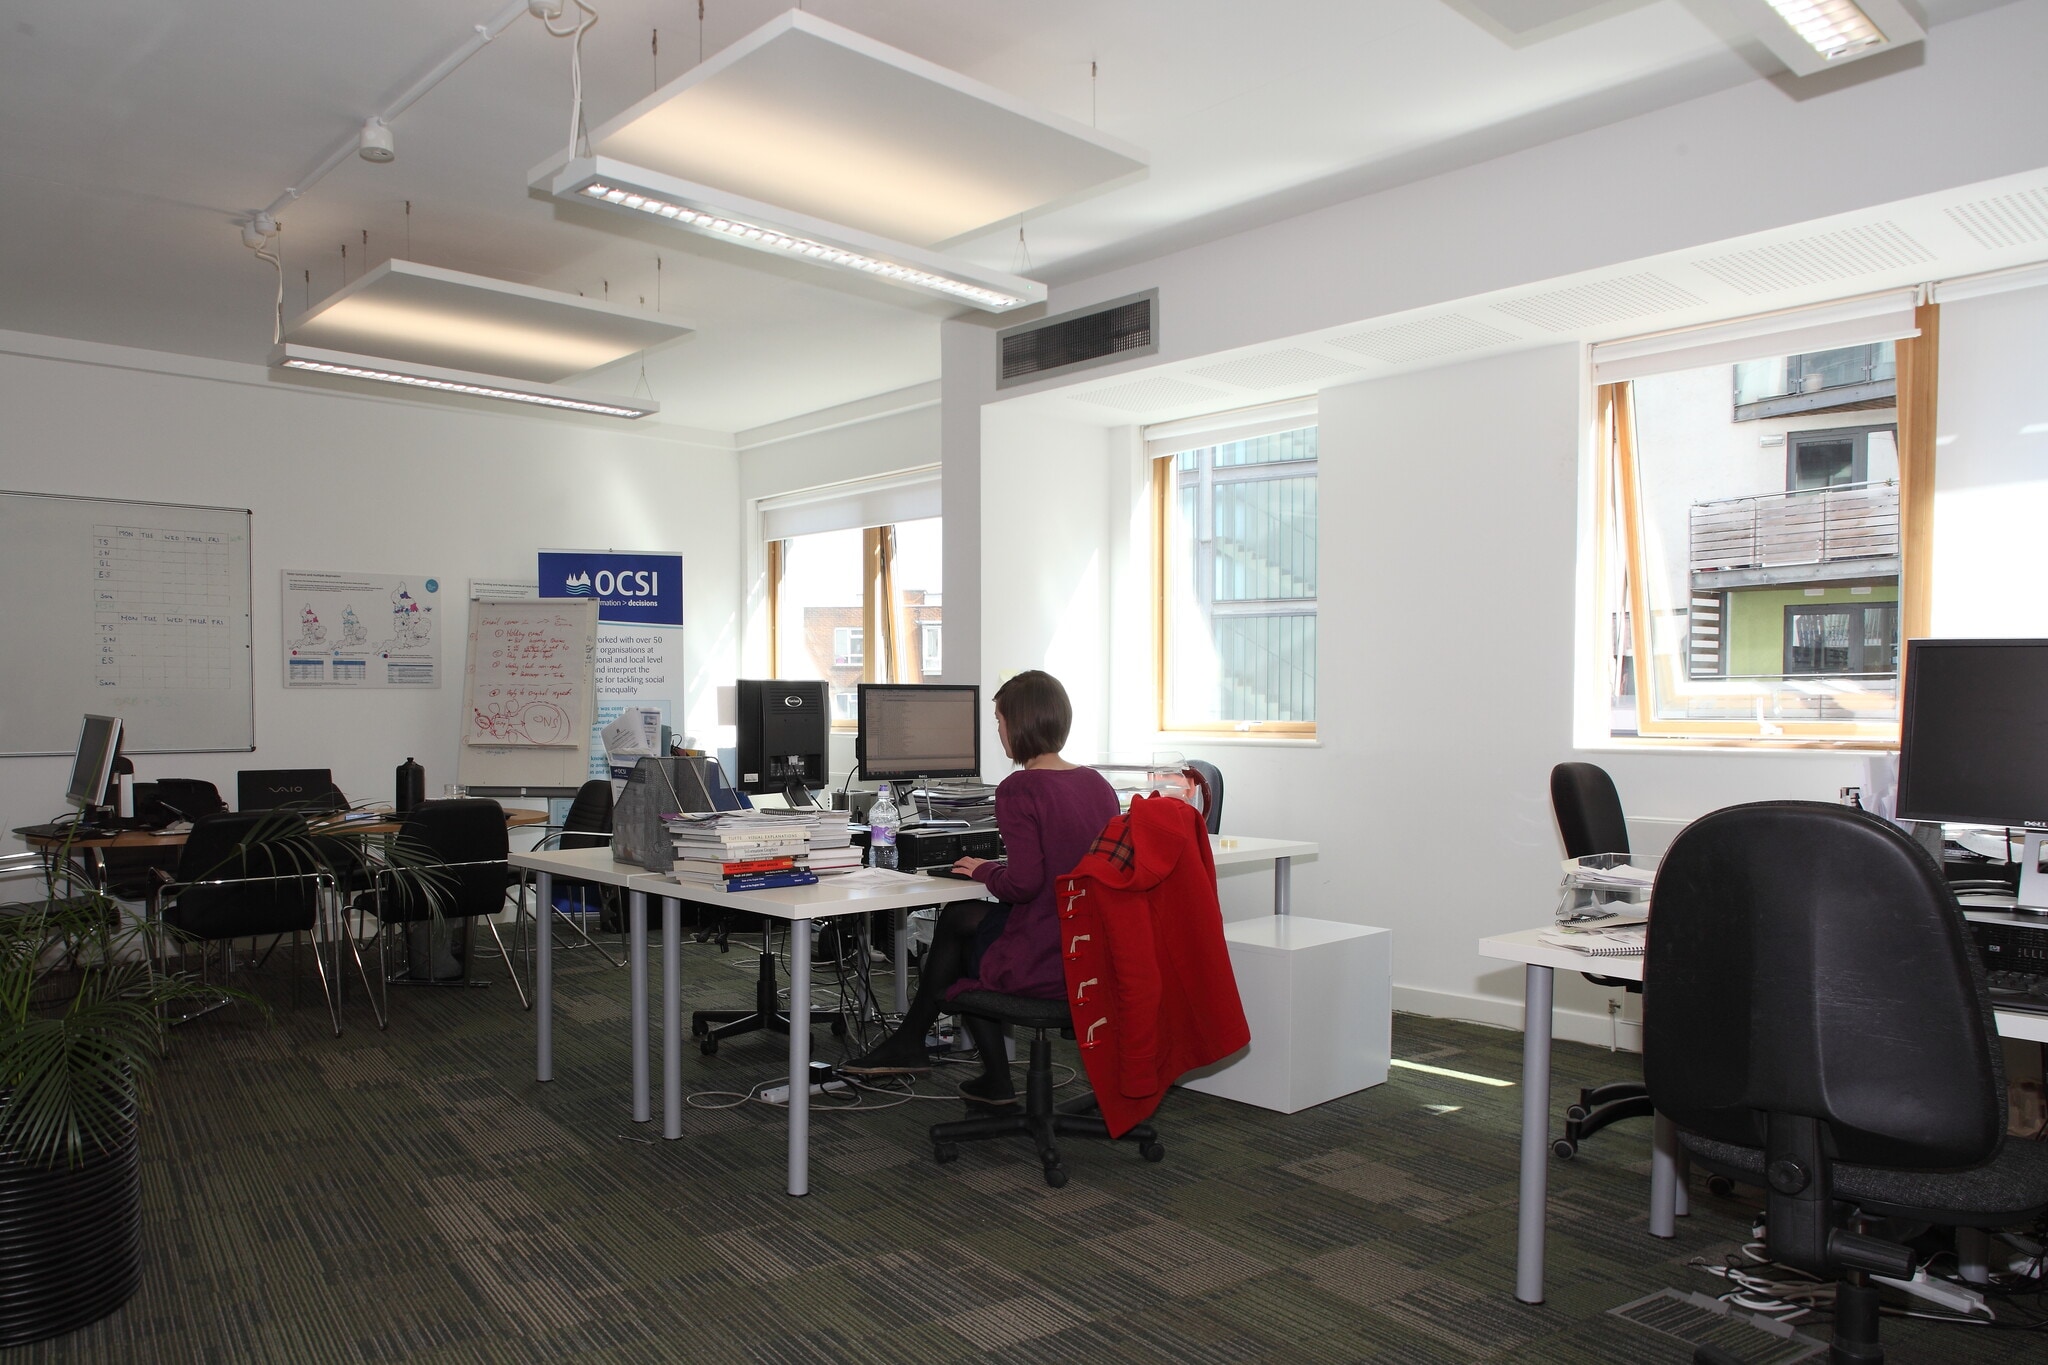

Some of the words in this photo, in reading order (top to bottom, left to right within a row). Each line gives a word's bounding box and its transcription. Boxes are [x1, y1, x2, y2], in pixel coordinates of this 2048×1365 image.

[595, 570, 658, 596] OCSI
[600, 646, 645, 655] organisations
[607, 666, 636, 675] interpret
[617, 676, 644, 685] tackling
[605, 686, 638, 695] inequality
[533, 714, 558, 728] ONS
